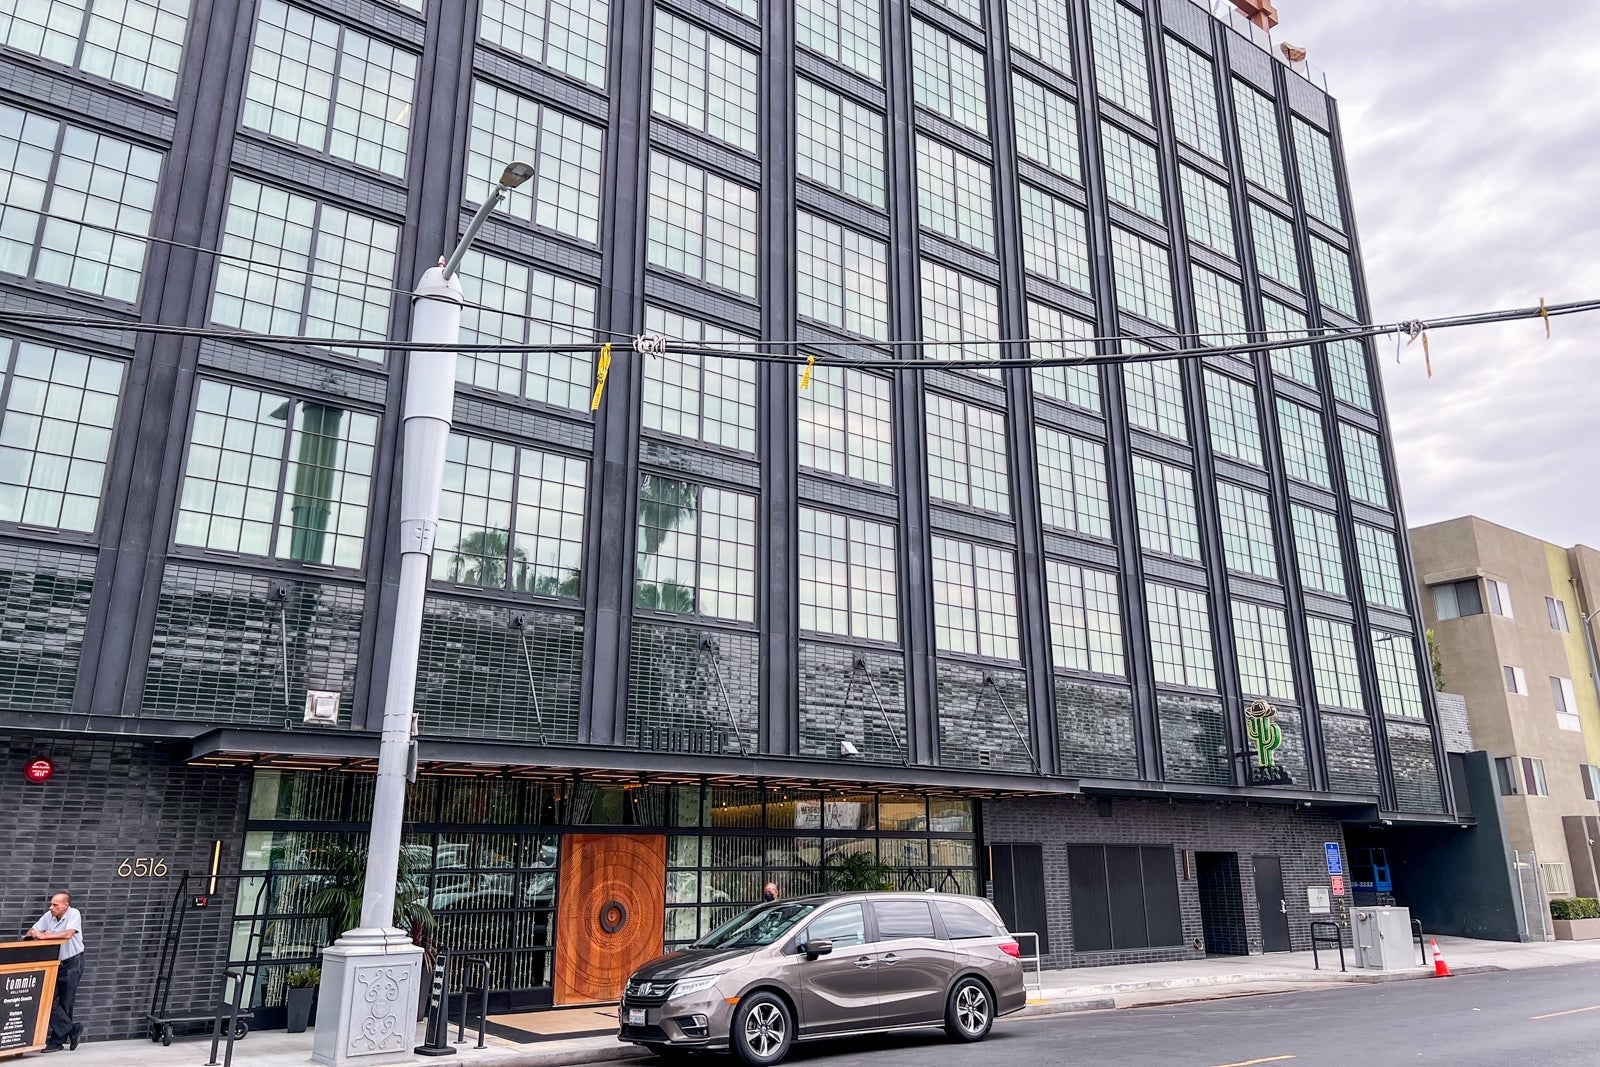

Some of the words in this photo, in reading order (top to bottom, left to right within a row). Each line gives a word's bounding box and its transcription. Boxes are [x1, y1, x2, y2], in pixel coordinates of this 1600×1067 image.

[1252, 766, 1281, 782] BAR
[117, 857, 168, 877] 6516
[6, 975, 36, 990] tommie
